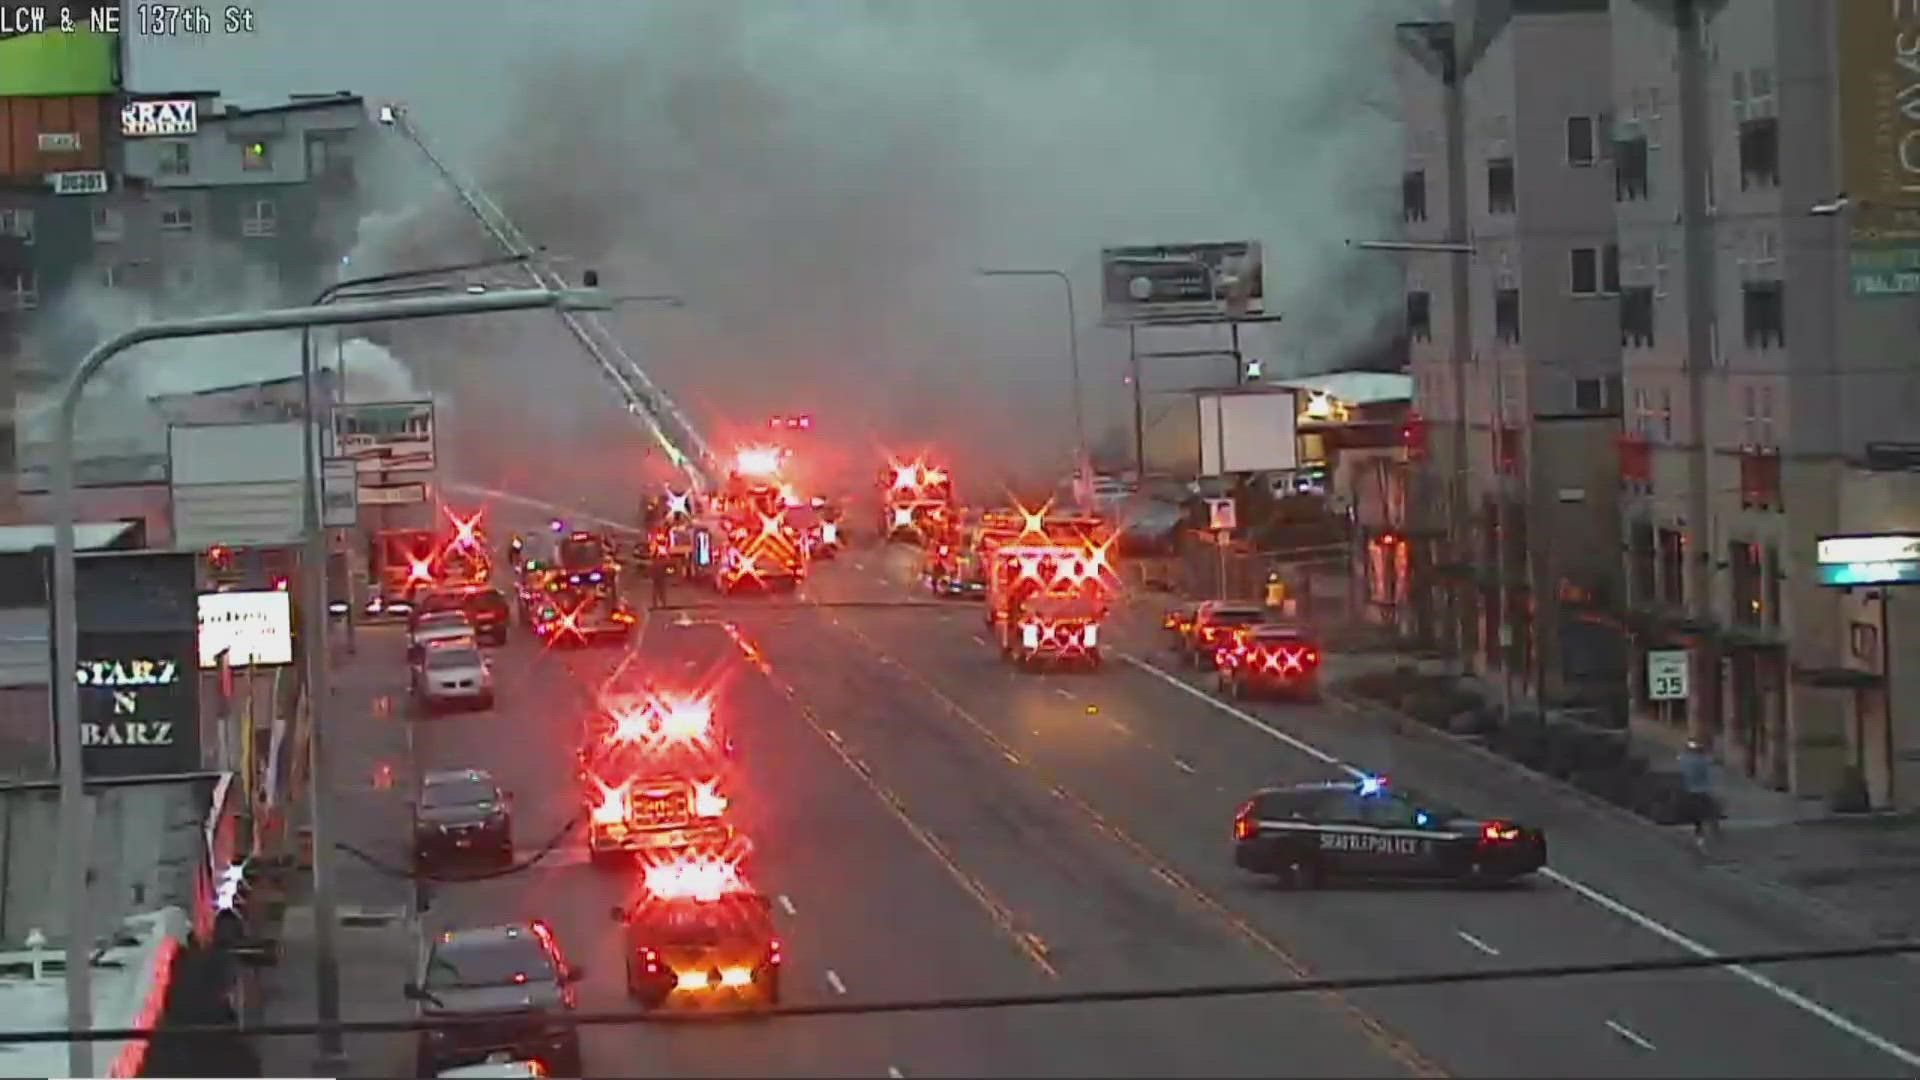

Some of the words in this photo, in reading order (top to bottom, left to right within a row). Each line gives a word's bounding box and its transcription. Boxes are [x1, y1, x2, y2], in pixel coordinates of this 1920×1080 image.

[77, 659, 178, 685] STARZ
[1656, 677, 1681, 695] 35
[112, 691, 138, 713] N
[81, 722, 173, 746] BARZ
